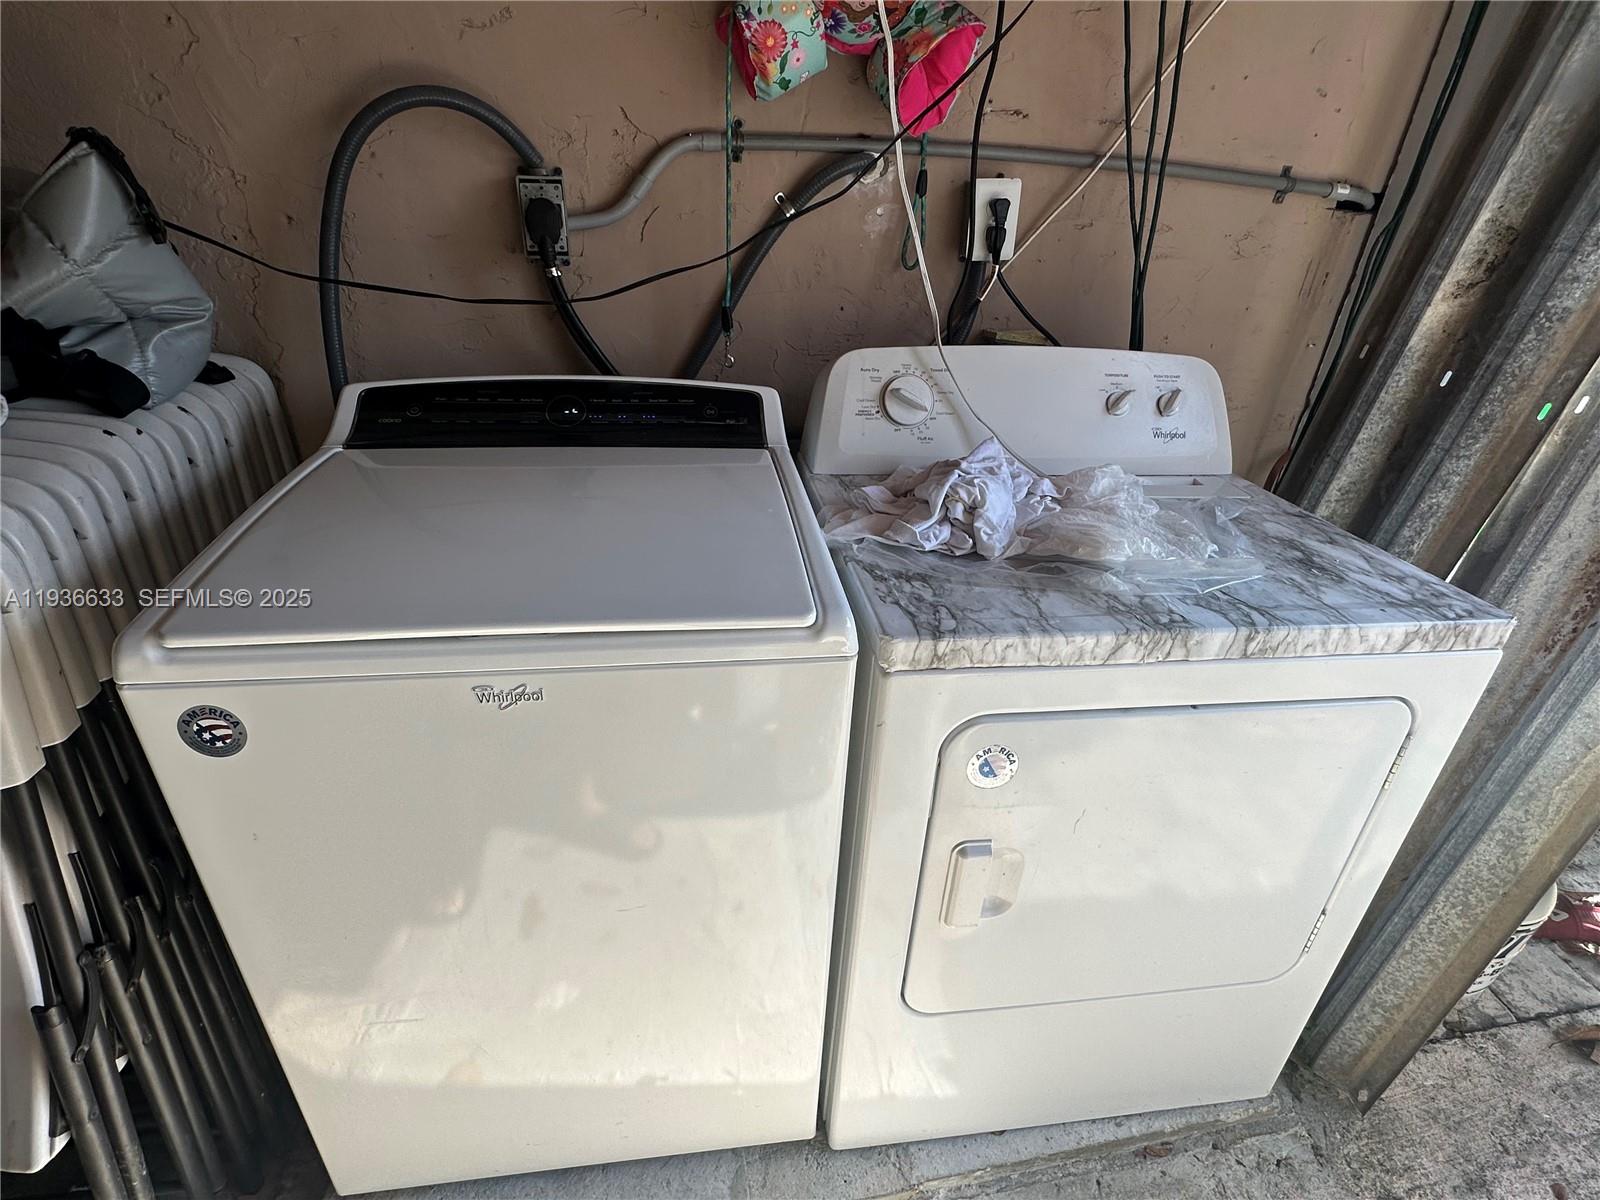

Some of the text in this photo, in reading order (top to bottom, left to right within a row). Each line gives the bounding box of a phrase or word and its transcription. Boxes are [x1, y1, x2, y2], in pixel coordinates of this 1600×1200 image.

[1152, 430, 1186, 441] Whirlpool
[475, 686, 545, 707] Whirlpool
[181, 706, 240, 729] AMERICA
